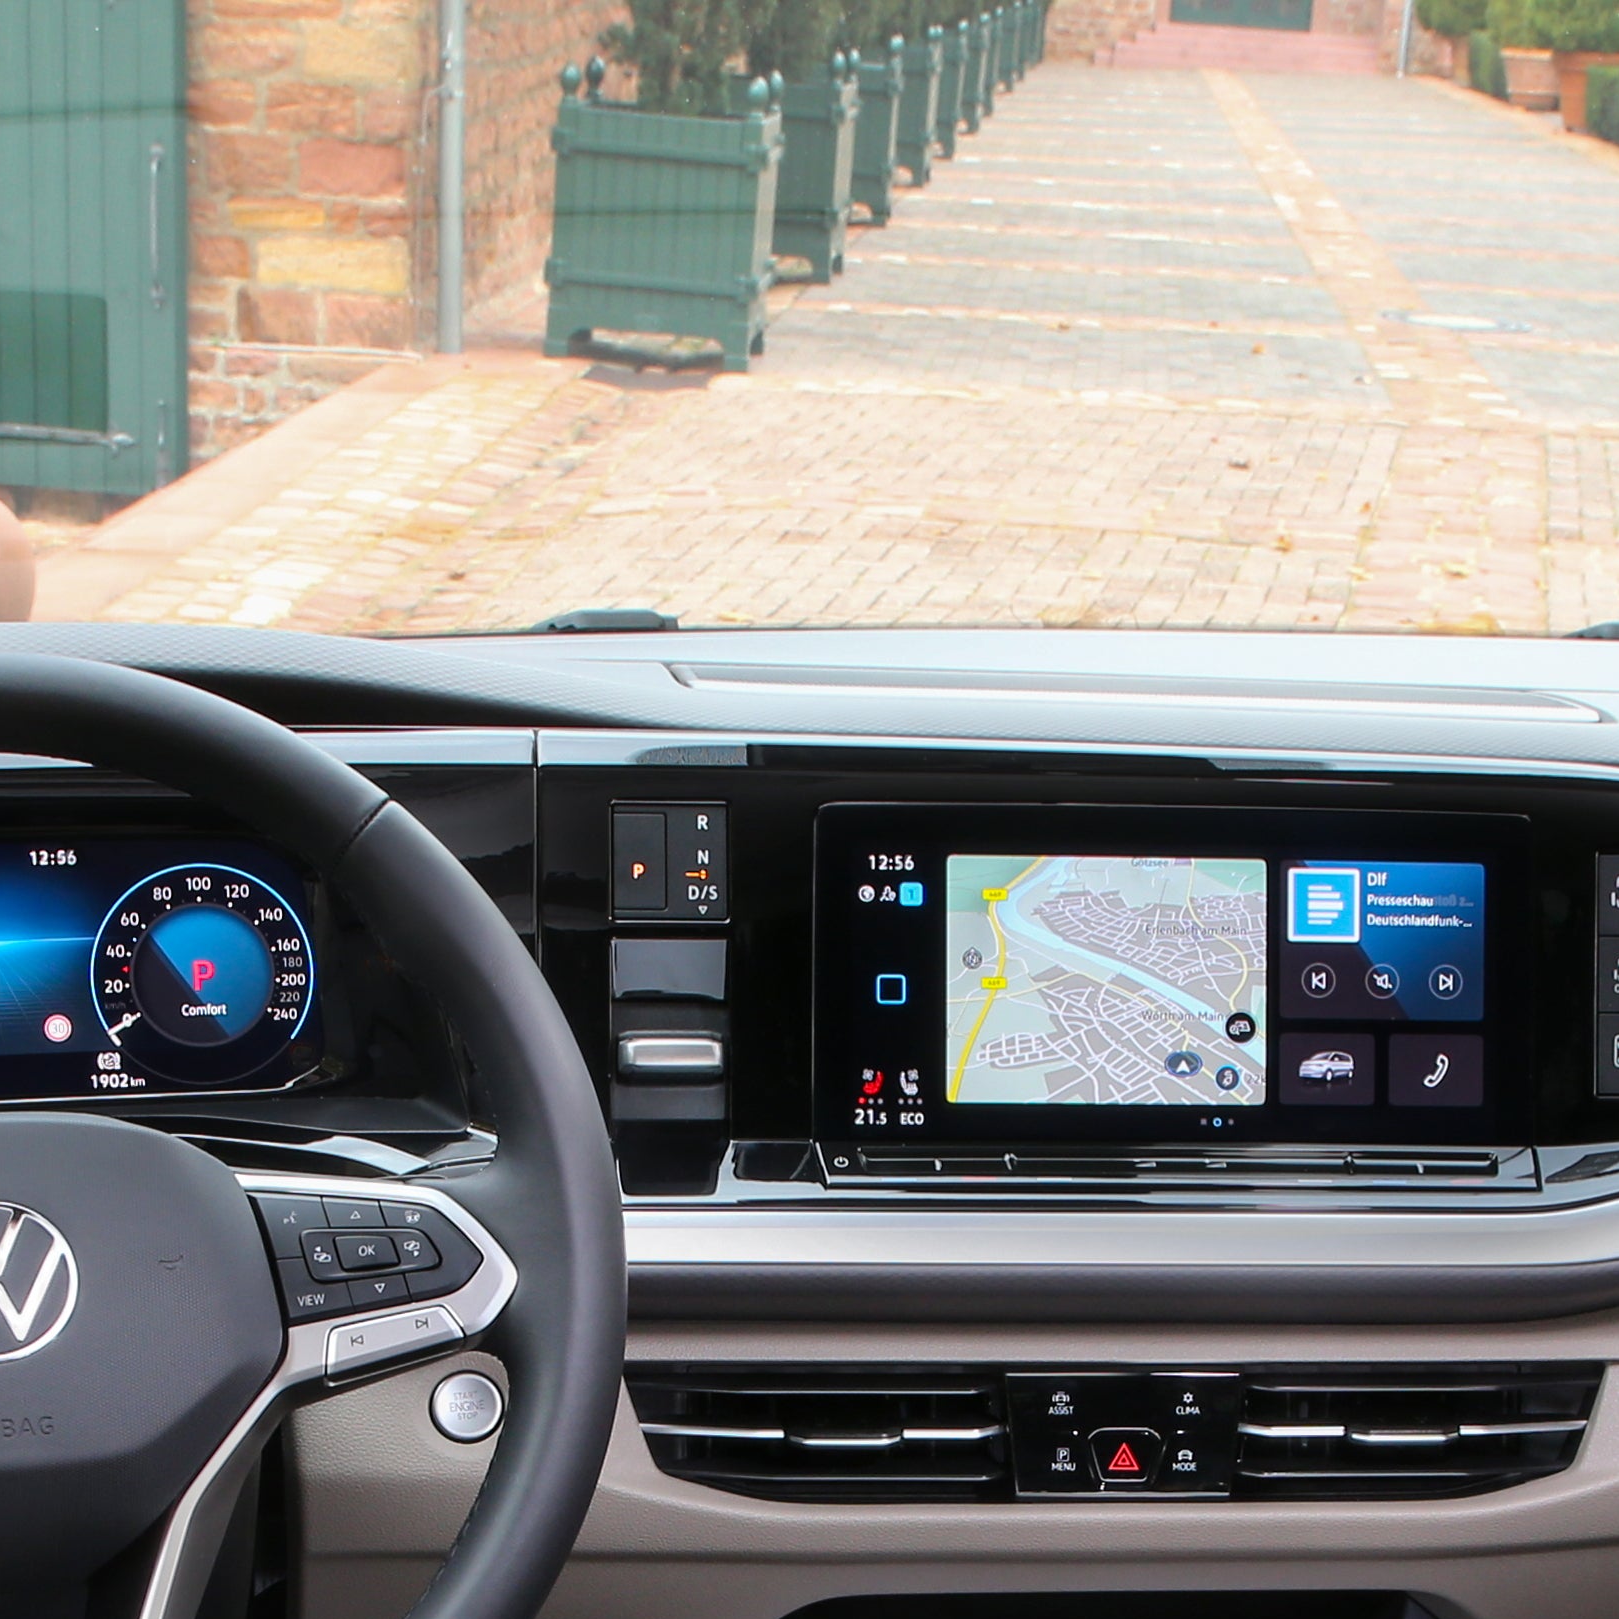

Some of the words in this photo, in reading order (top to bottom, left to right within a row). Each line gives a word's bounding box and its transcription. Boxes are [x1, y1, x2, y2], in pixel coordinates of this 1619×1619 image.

[696, 814, 709, 831] R
[29, 849, 78, 866] 12:56
[697, 849, 709, 866] N
[868, 854, 915, 871] 12:56
[632, 863, 646, 880] P
[185, 876, 212, 891] 100
[1366, 872, 1388, 887] Dlf
[152, 886, 173, 901] 80
[224, 884, 250, 899] 120
[687, 885, 719, 901] D/S
[1366, 893, 1434, 907] Presseschau
[120, 912, 140, 927] 60
[258, 907, 283, 922] 140
[1145, 923, 1199, 936] Erlenbach
[1221, 925, 1247, 935] Main
[106, 944, 125, 958] 40
[277, 938, 300, 952] 160
[282, 956, 303, 967] 180
[192, 959, 215, 992] P
[281, 973, 306, 986] 200
[104, 979, 124, 994] 20
[279, 991, 300, 1002] 220
[181, 1003, 228, 1017] Comfort
[273, 1007, 298, 1020] 240
[1198, 1011, 1224, 1022] Main
[51, 1022, 65, 1035] 30
[854, 1108, 888, 1126] 21.5
[899, 1111, 925, 1126] ECO
[358, 1244, 376, 1257] OK
[296, 1293, 326, 1307] VIEW
[449, 1400, 486, 1413] ENGINE
[1047, 1405, 1074, 1416] ASSIST
[1175, 1405, 1201, 1416] CLIMA
[1051, 1462, 1077, 1472] MENU
[1172, 1462, 1198, 1472] MODE
